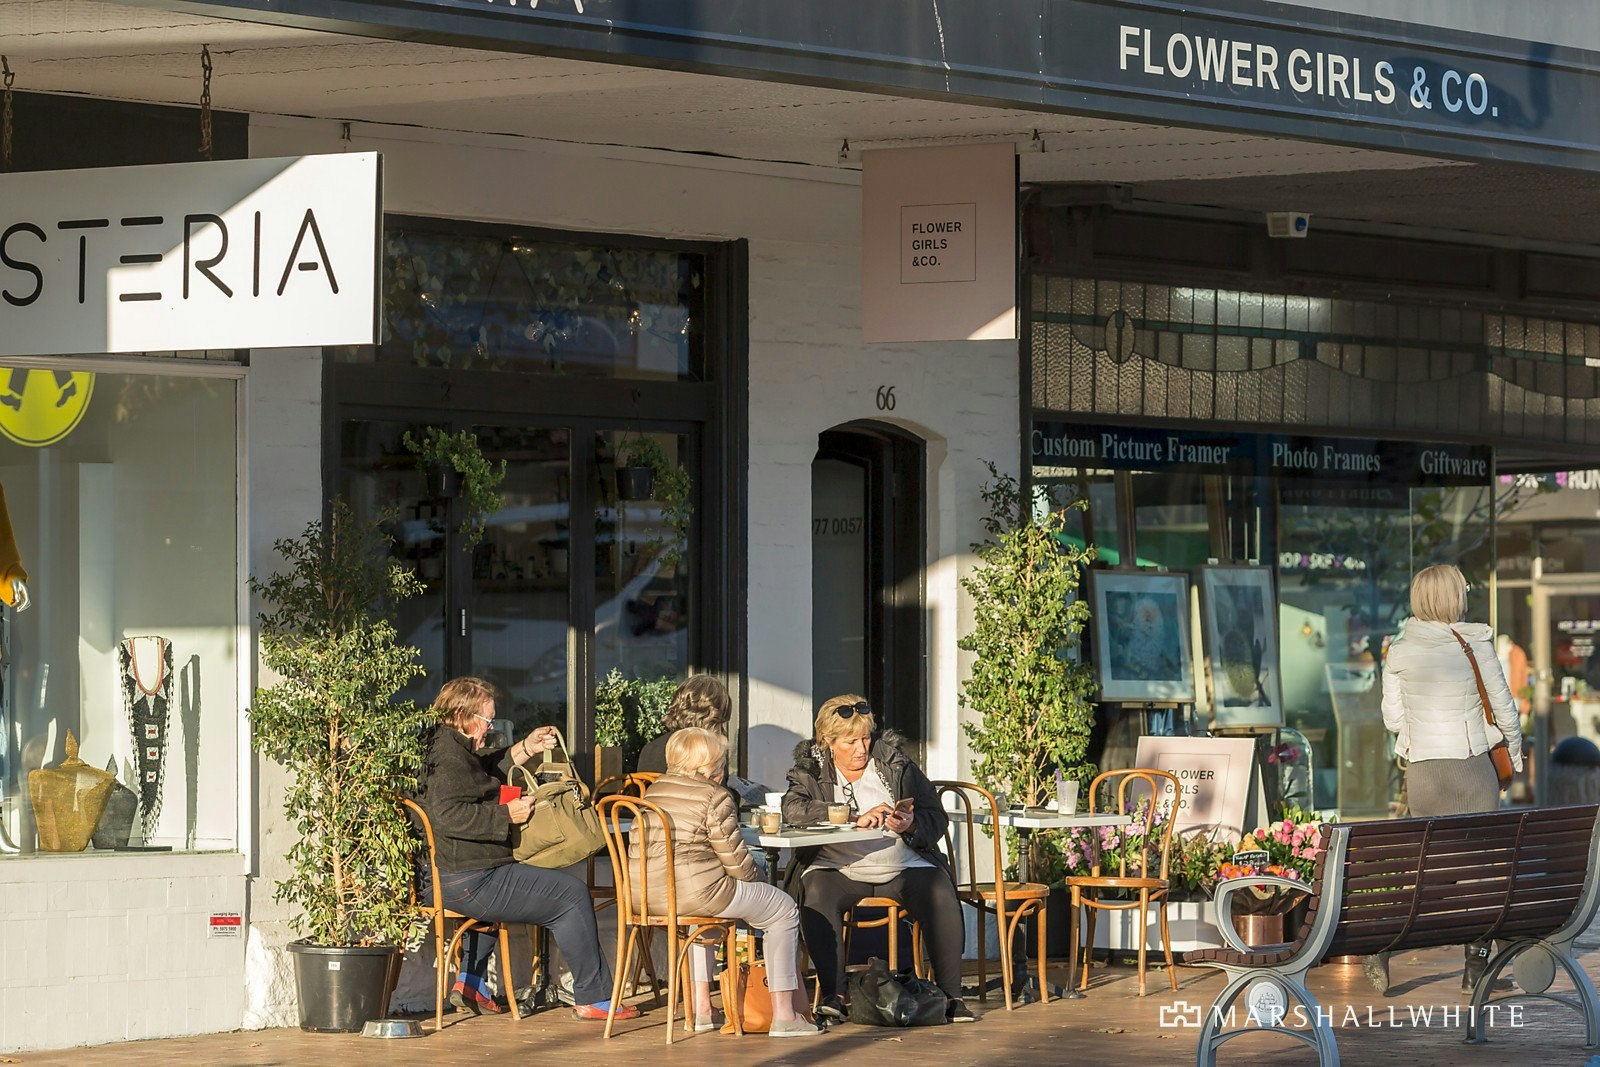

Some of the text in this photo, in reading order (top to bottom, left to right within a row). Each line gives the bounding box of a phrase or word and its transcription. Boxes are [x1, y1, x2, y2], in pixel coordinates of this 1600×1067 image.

[1119, 25, 1499, 118] FLOWER GIRLS & CO.
[912, 221, 962, 234] FLOWER
[0, 207, 340, 307] STERIA
[912, 239, 948, 250] GIRLS
[912, 255, 941, 267] &CO.
[876, 385, 896, 411] 66
[1031, 429, 1230, 464] Custom Picture Framer
[1271, 442, 1381, 472] Photo Frames
[1419, 450, 1487, 477] Giftware
[812, 517, 863, 535] 77 0057
[1165, 784, 1199, 795] GRLS
